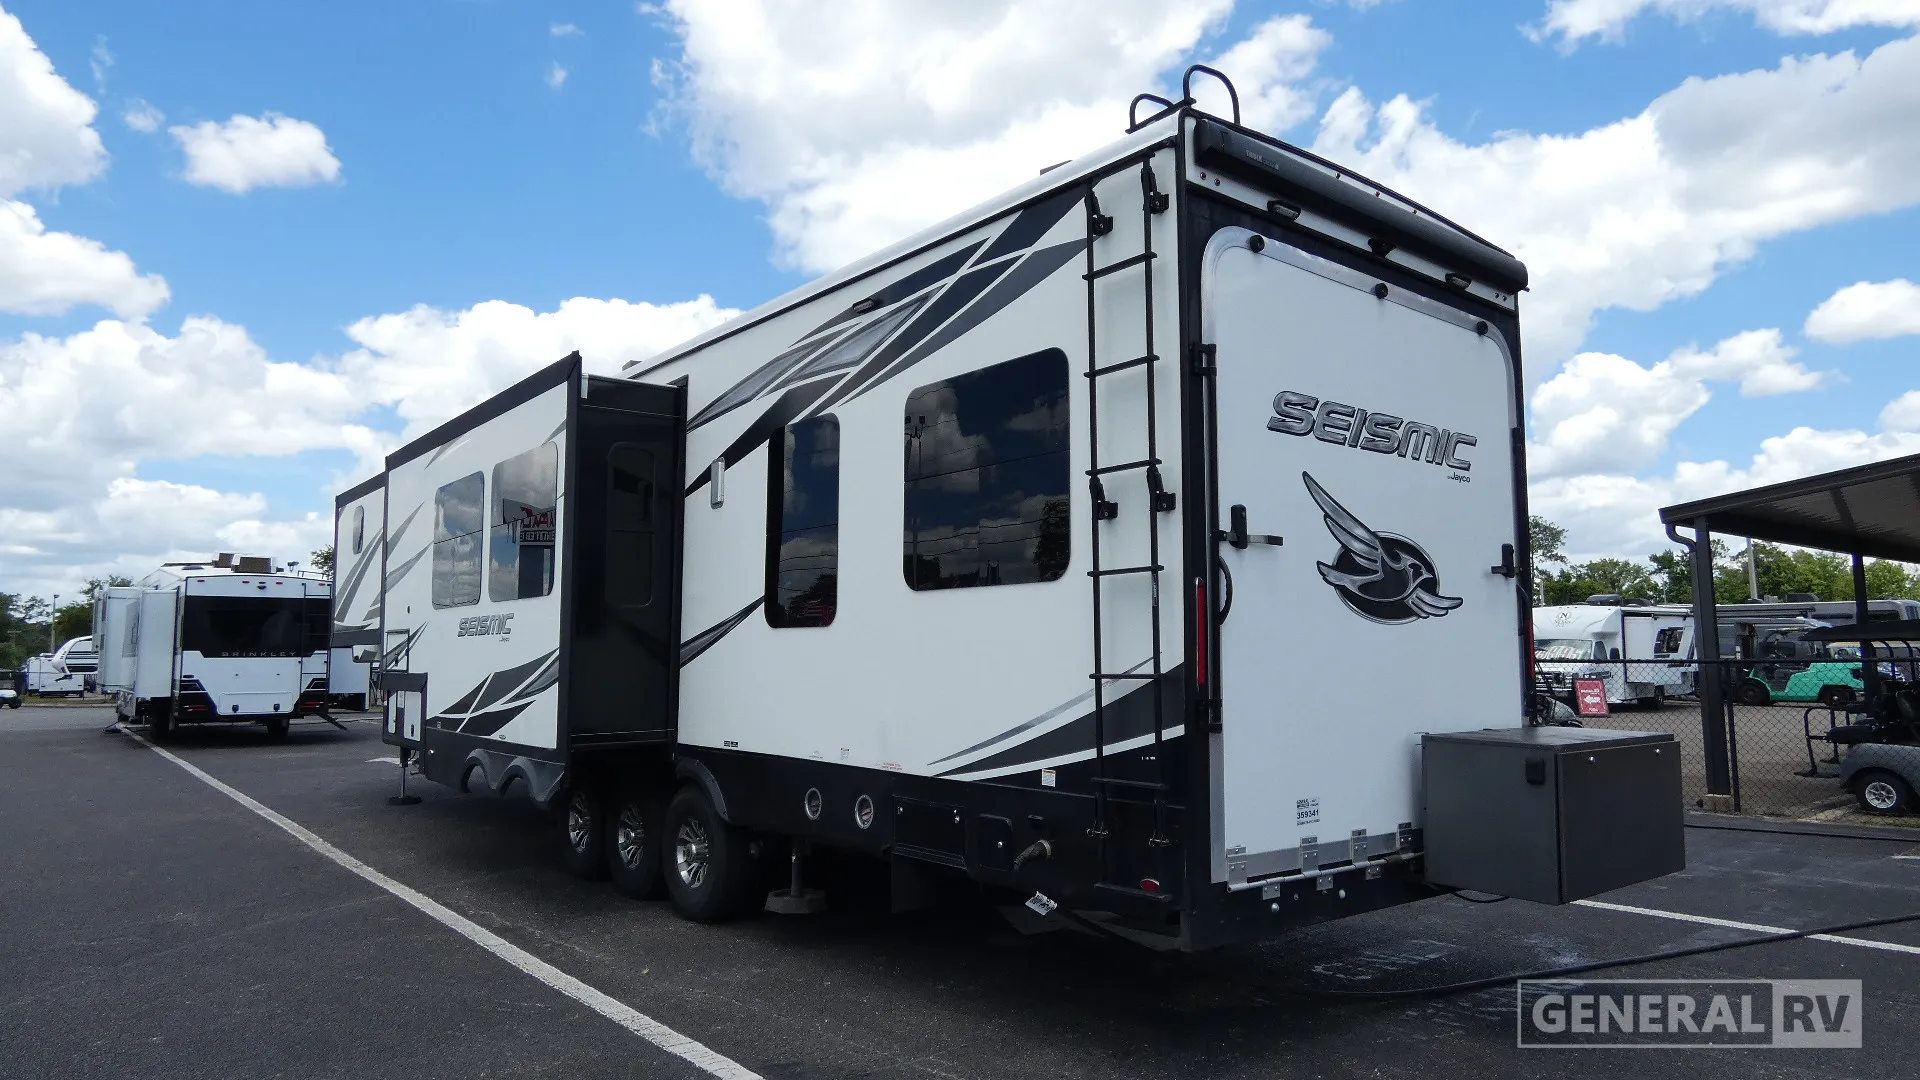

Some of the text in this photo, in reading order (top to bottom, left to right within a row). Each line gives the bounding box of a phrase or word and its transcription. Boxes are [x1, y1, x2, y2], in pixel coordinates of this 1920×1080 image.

[1266, 390, 1478, 472] SEISMIC
[457, 612, 515, 637] SEISMIC
[1296, 809, 1319, 820] 359341
